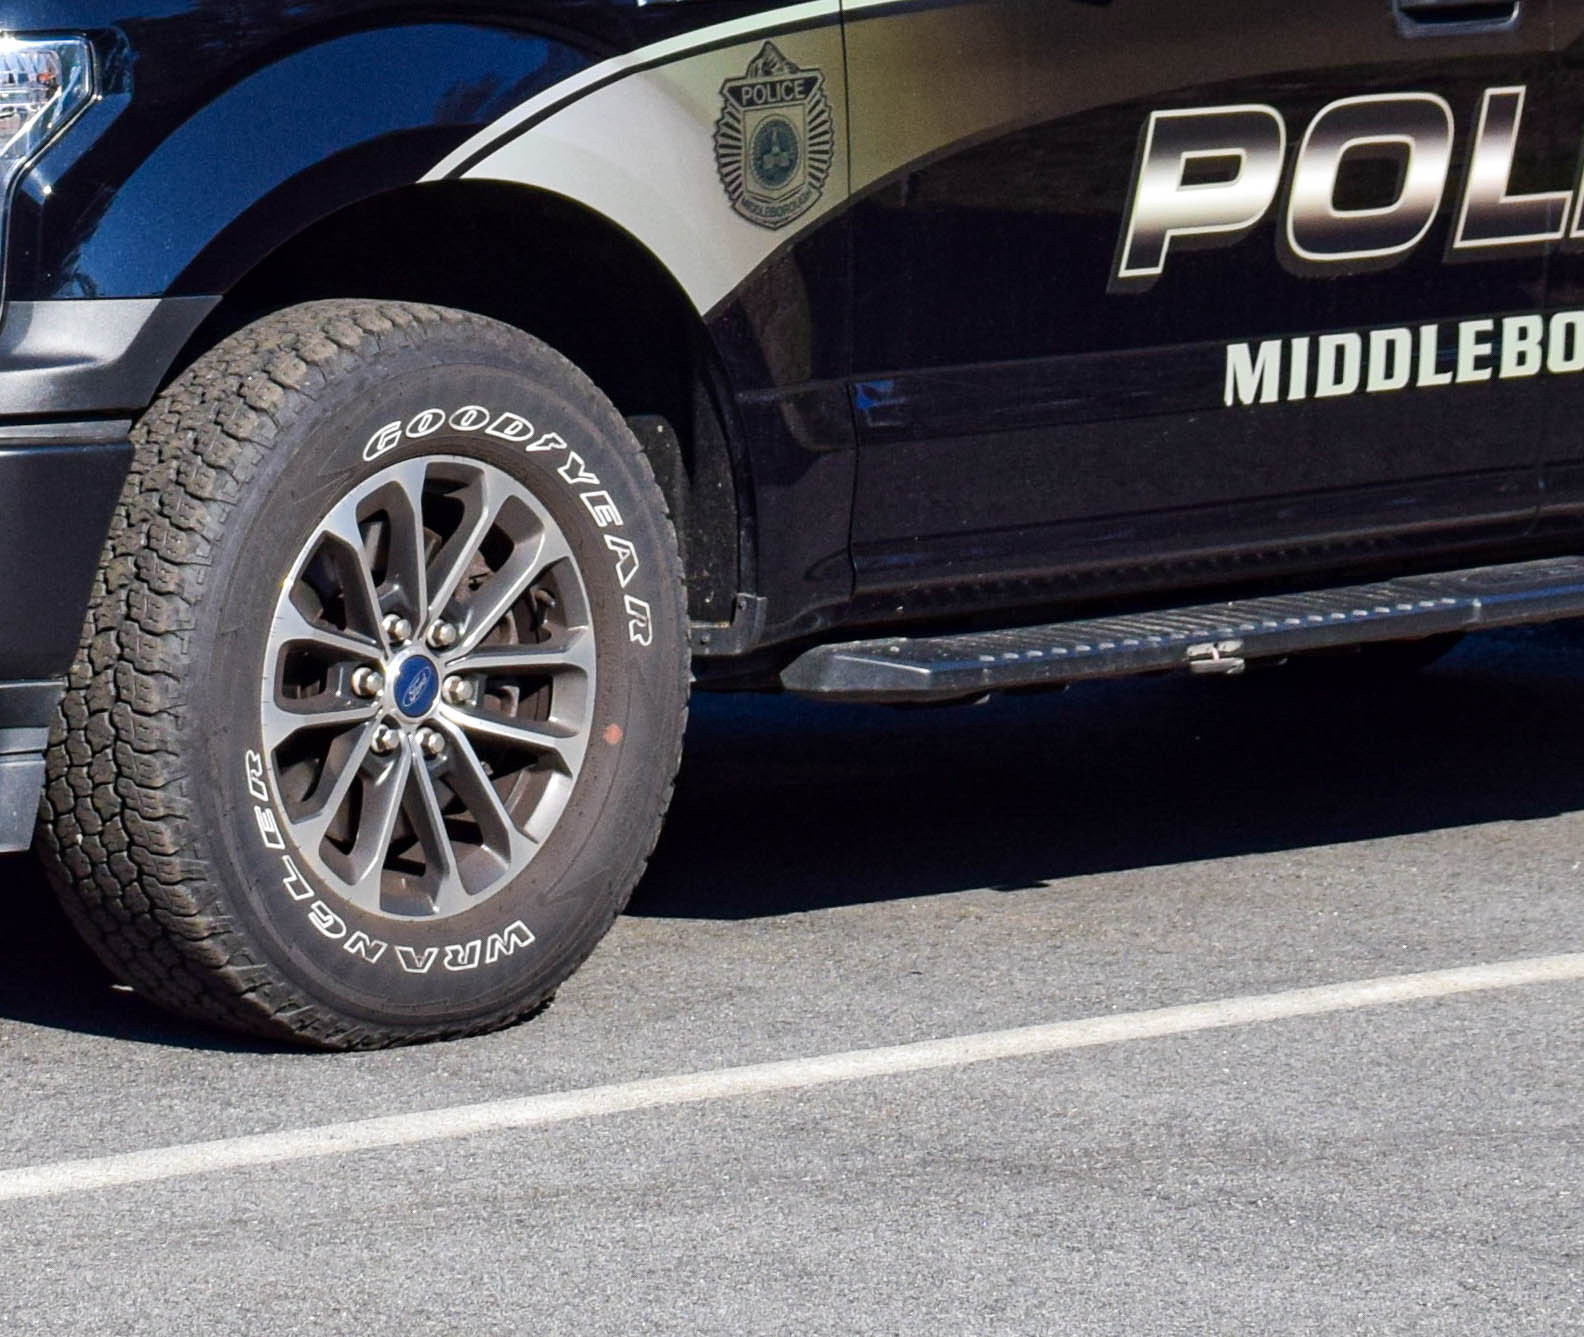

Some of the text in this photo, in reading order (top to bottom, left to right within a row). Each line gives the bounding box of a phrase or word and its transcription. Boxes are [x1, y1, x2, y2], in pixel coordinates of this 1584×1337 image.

[741, 79, 806, 107] POLICE
[363, 404, 652, 647] GOODYEAR
[244, 758, 535, 974] WRANGLER
